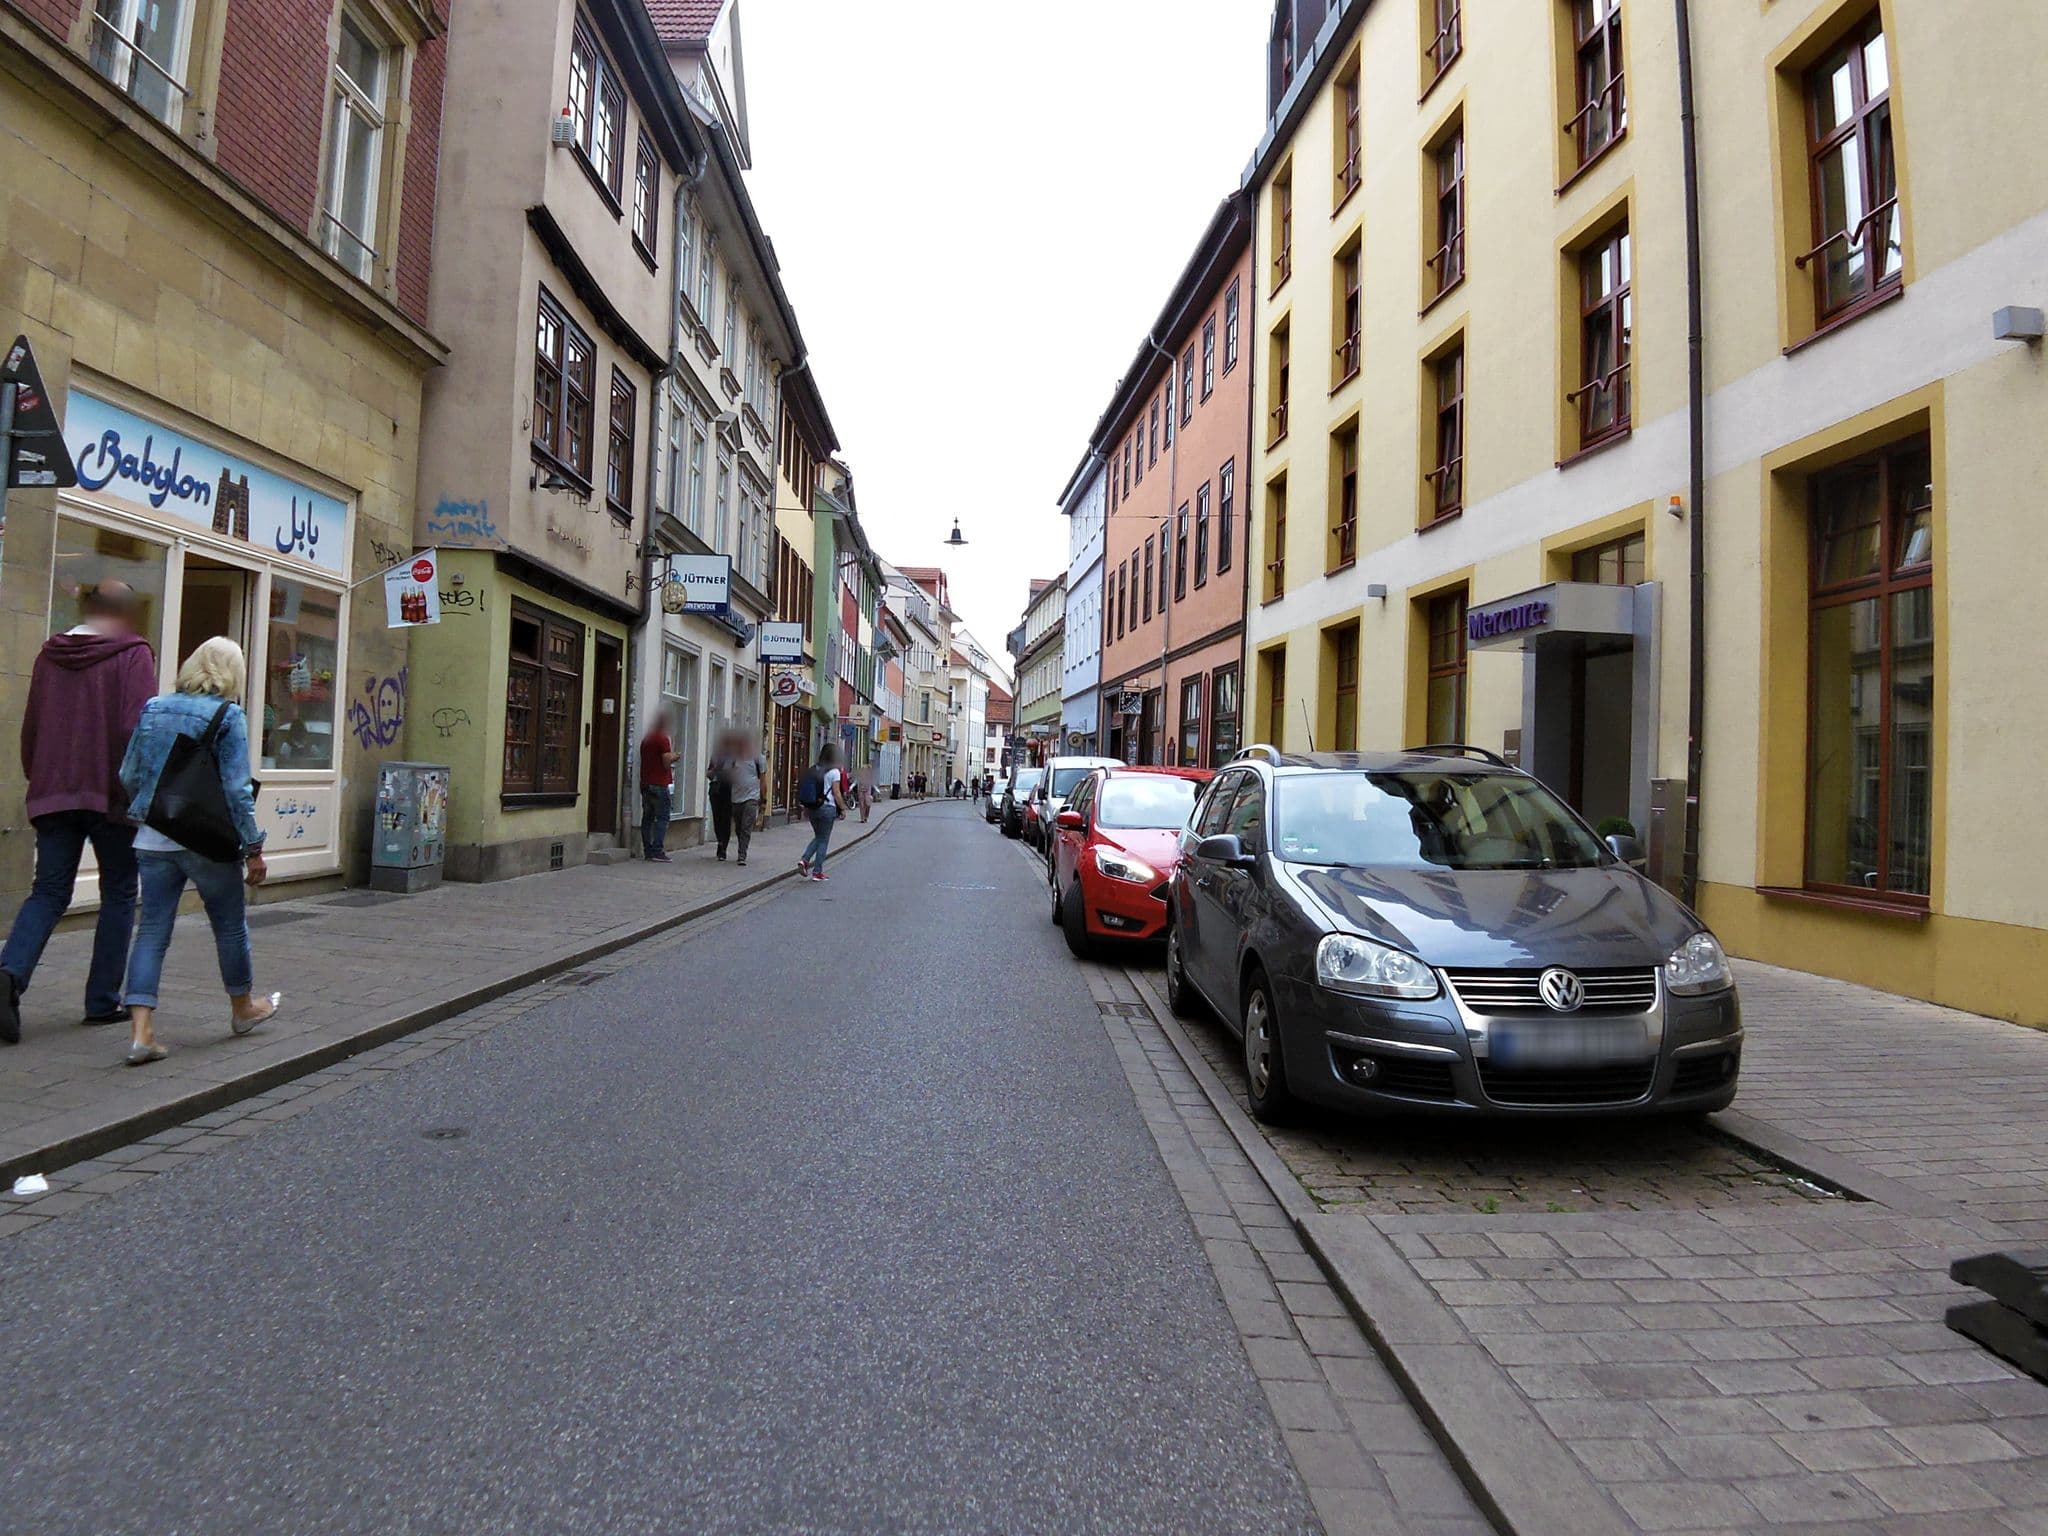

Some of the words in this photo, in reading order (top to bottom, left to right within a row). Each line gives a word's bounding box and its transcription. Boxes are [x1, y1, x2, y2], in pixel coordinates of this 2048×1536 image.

[77, 429, 211, 508] Babylon
[276, 496, 319, 560] بابل
[683, 573, 727, 585] JÜTTNER
[770, 635, 800, 644] JÜTTNER
[1469, 601, 1543, 640] Mercure
